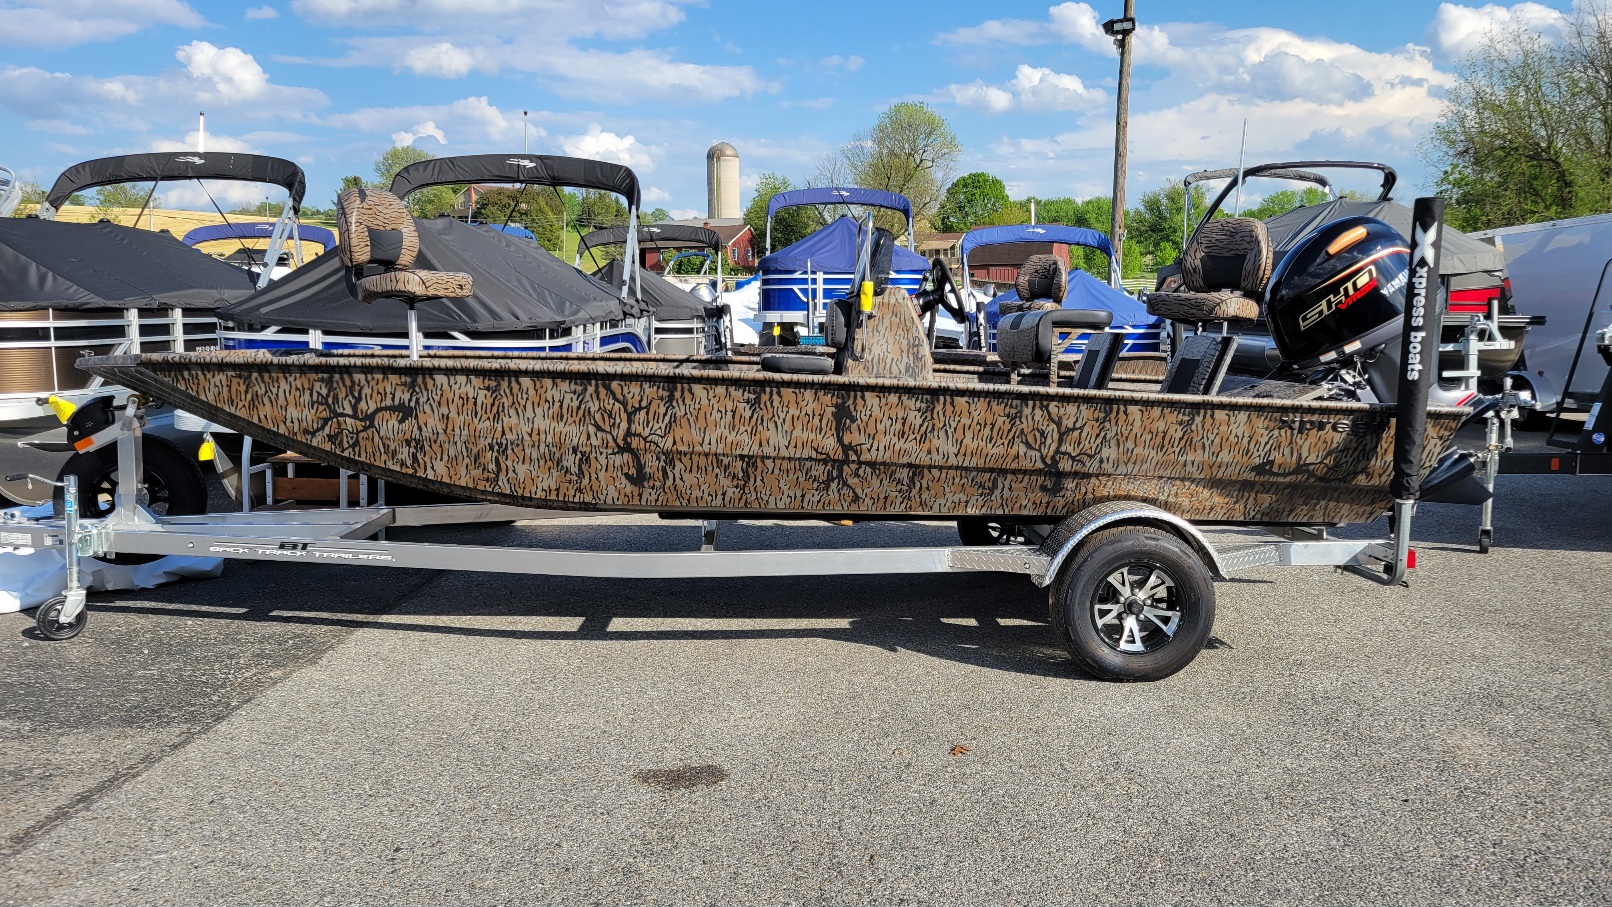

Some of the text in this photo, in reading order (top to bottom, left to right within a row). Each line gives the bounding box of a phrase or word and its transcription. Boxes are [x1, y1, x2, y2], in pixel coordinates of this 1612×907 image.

[1299, 264, 1377, 331] SHO
[1380, 267, 1409, 298] YAMAH
[1411, 266, 1428, 327] xpress
[1407, 331, 1426, 380] boats
[209, 546, 249, 554] BACK
[255, 548, 308, 557] TRACK
[277, 541, 316, 551] BT
